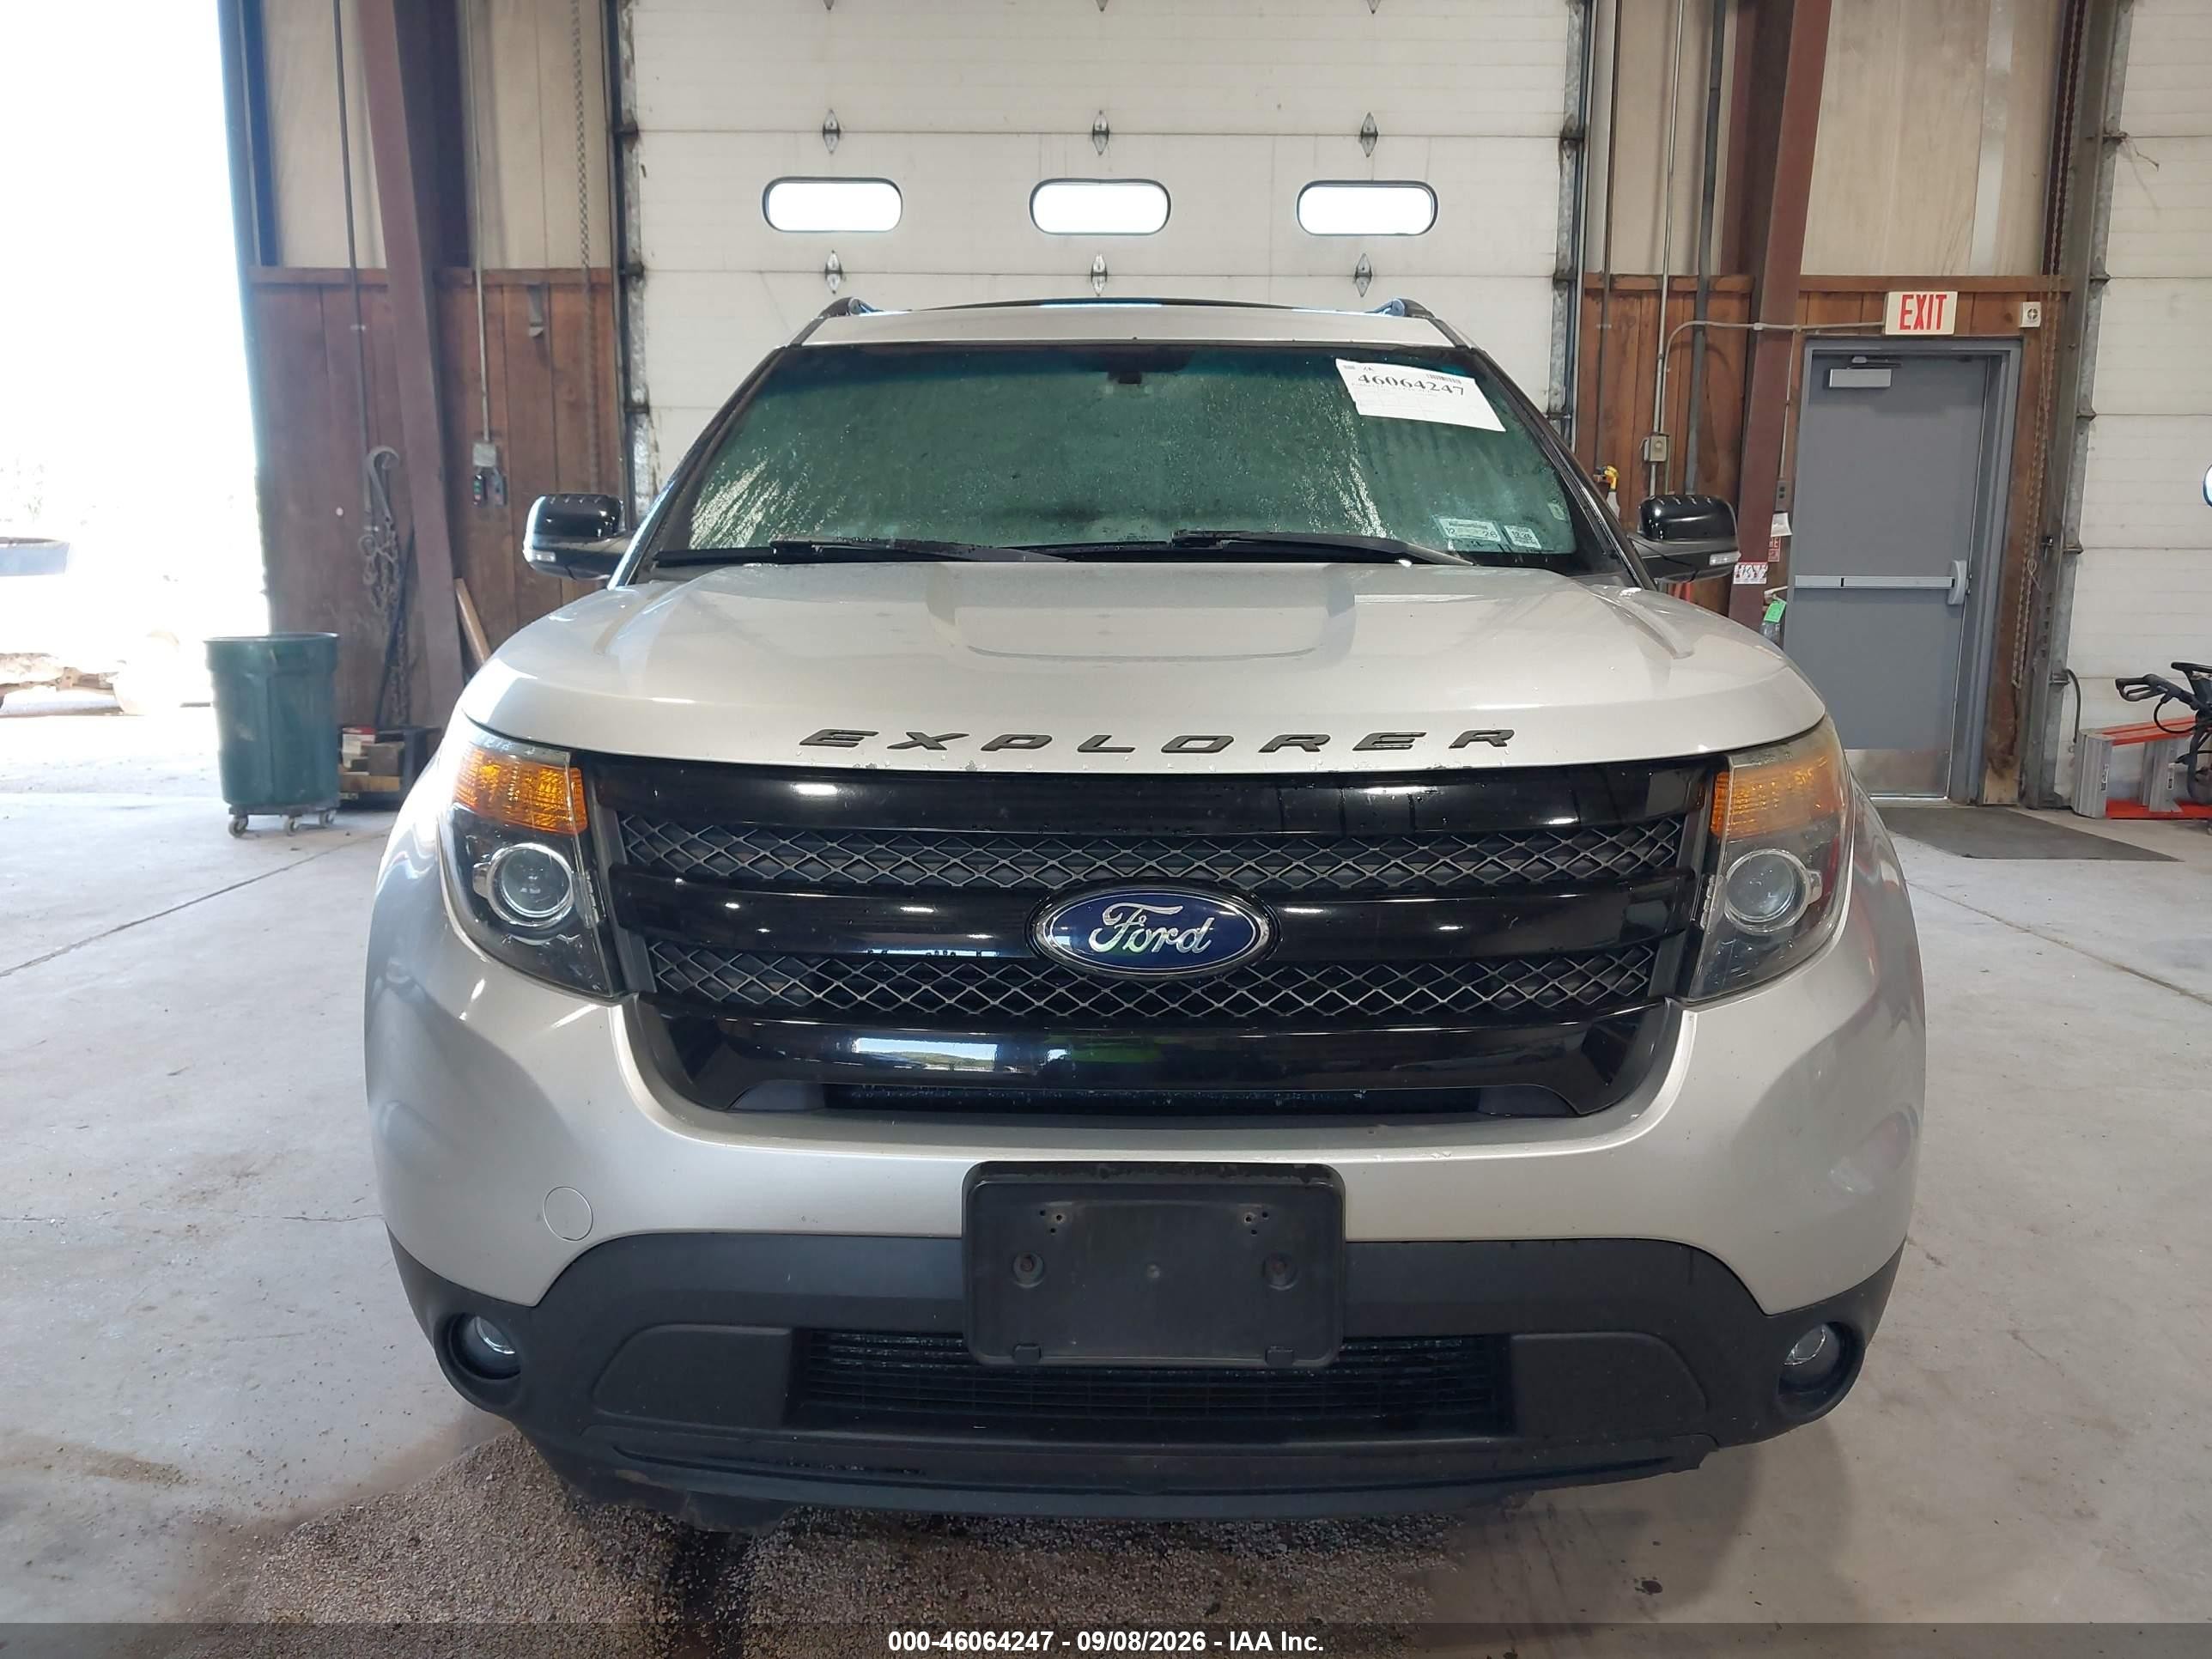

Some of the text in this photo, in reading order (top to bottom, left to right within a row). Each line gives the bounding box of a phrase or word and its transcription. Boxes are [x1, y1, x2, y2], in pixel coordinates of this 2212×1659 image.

[1899, 294, 1948, 331] EXIT
[1358, 374, 1464, 396] 46064247
[799, 728, 1515, 754] EXPLORER
[1088, 902, 1215, 954] Ford
